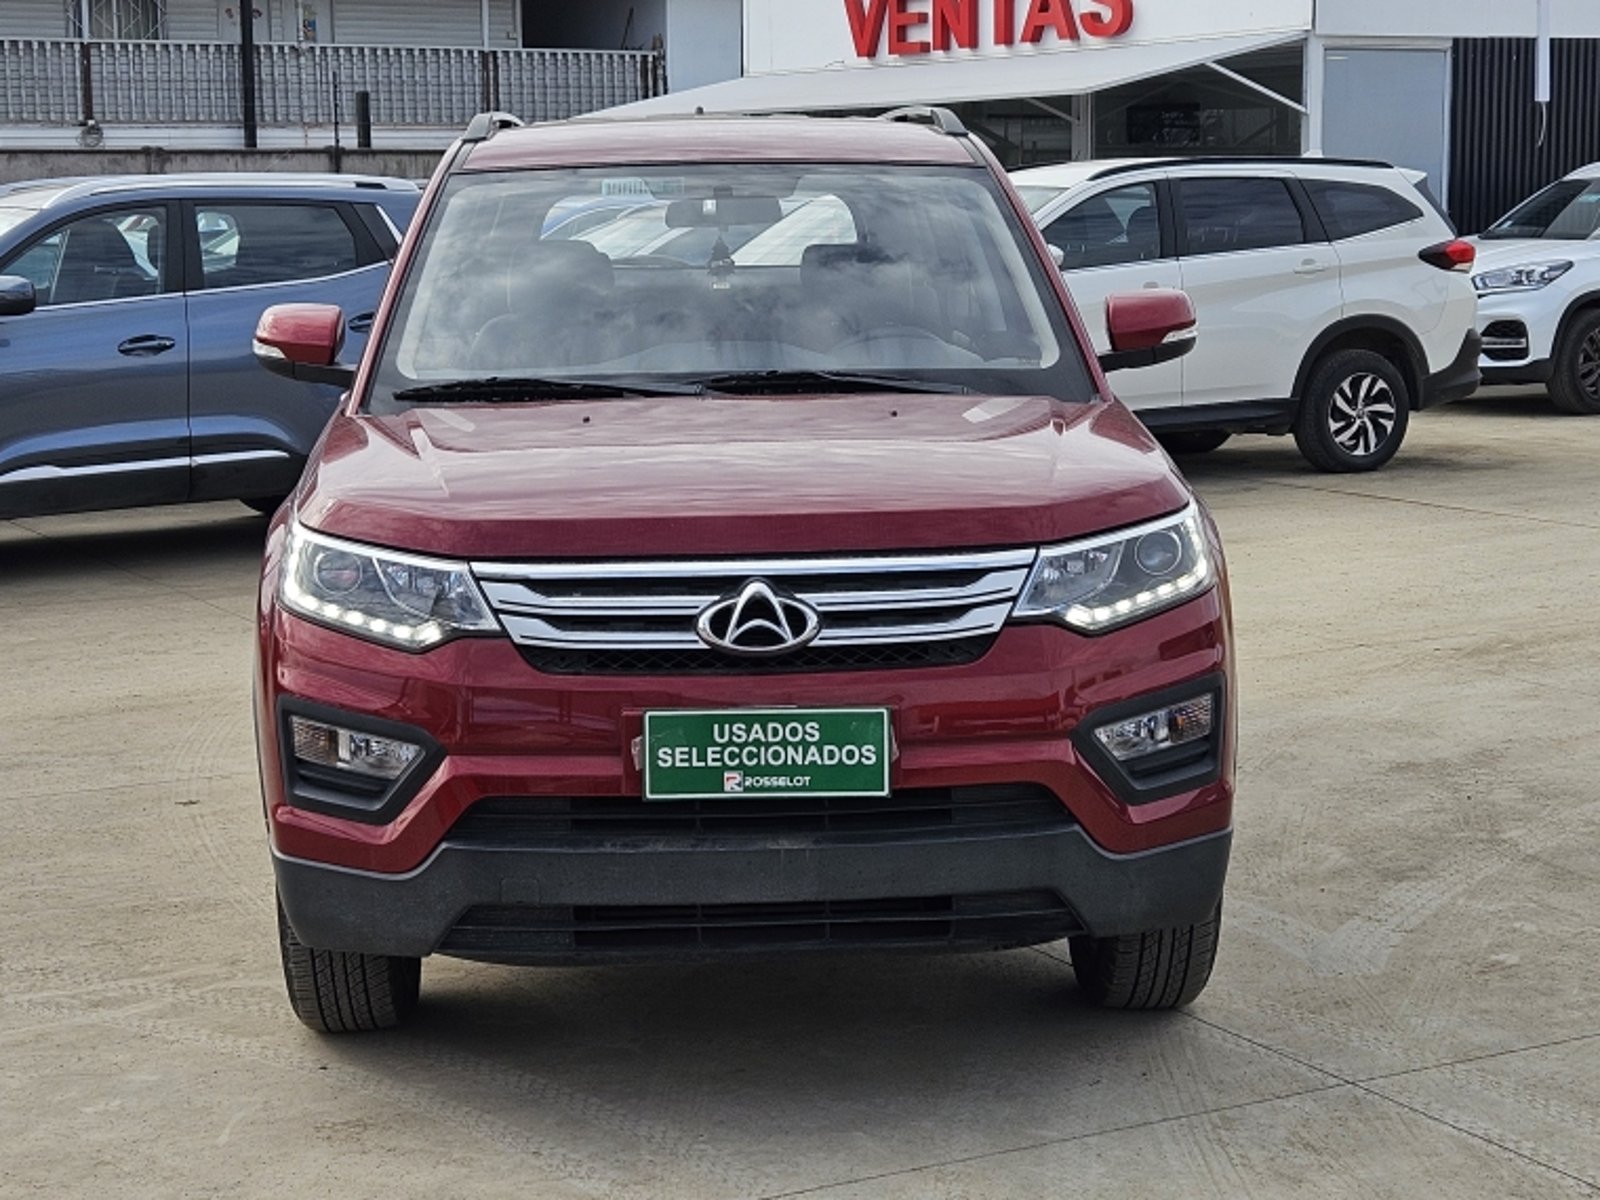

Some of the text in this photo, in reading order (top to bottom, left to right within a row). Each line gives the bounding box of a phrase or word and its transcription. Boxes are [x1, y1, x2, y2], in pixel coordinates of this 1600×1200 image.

[713, 721, 820, 743] USADOS
[657, 745, 877, 768] SELECCIONADOS
[744, 776, 811, 787] ROSSELOT
